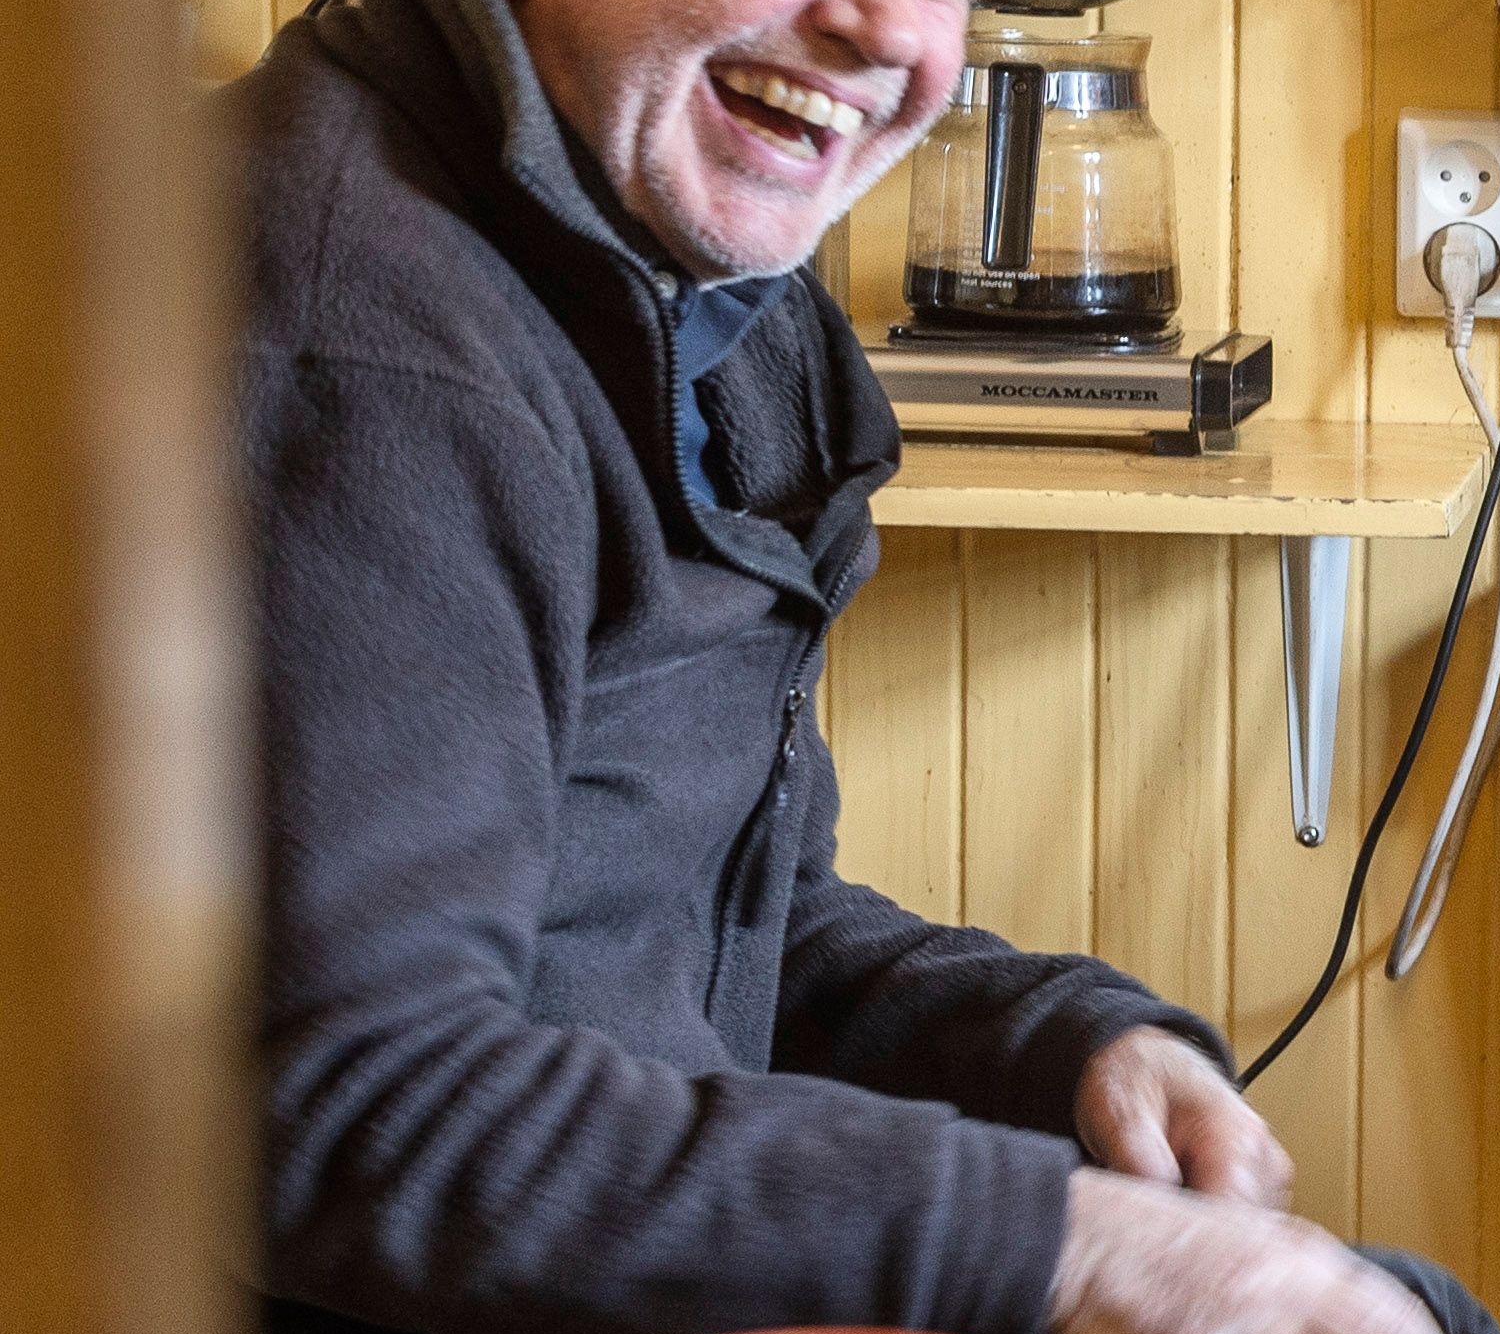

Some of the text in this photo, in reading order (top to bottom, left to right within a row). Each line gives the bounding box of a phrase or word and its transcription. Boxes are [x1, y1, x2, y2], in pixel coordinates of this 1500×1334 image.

[988, 270, 1004, 279] use
[1005, 270, 1017, 280] on
[1018, 271, 1041, 282] open
[980, 384, 1159, 402] MOCCAMASTER
